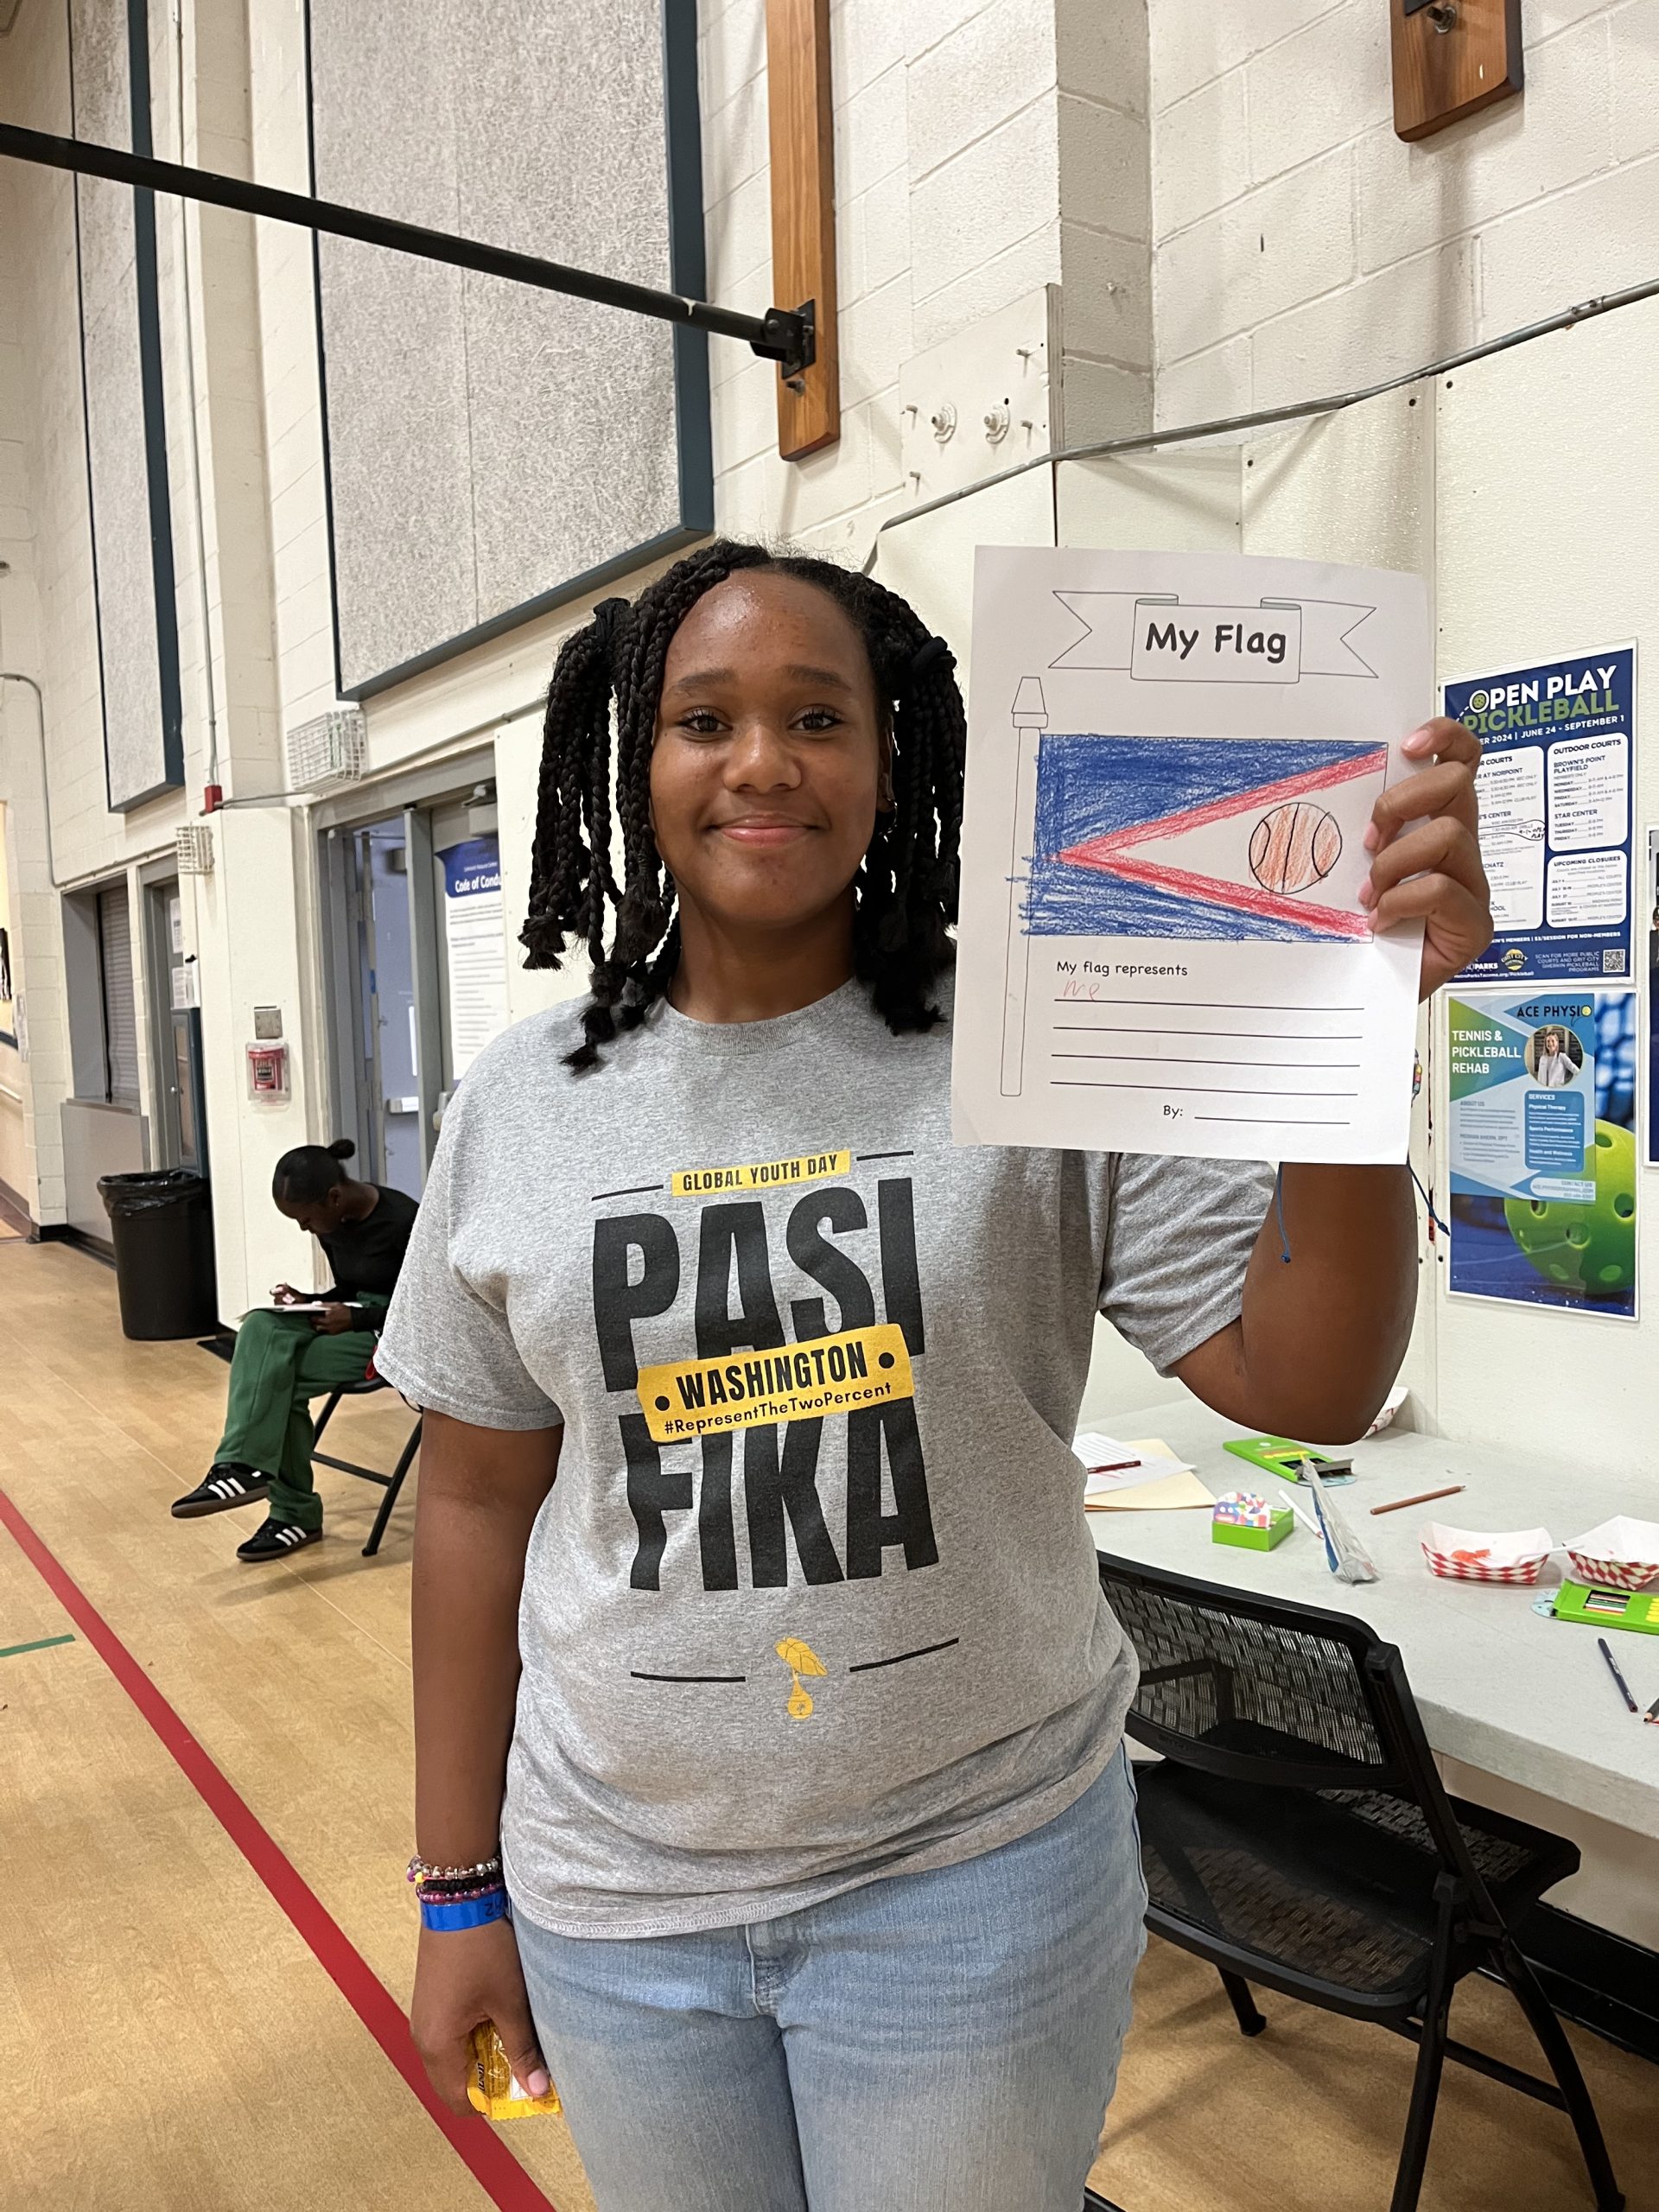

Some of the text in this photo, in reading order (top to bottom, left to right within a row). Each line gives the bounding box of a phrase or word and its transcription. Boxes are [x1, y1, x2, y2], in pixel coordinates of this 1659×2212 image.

[1146, 623, 1286, 664] My Flag
[1469, 664, 1617, 713] OPEN PLAY
[1462, 690, 1619, 734] PICKLEBALL
[1491, 734, 1512, 744] 2024
[1521, 727, 1543, 739] JUNE
[1546, 726, 1556, 736] 24
[1564, 716, 1618, 732] SEPTEMBER
[1554, 739, 1621, 755] OUTDOOR COURTS
[1485, 756, 1513, 766] COURTS
[1586, 755, 1605, 764] POINT
[1553, 765, 1589, 774] PLAYFIELD
[454, 879, 470, 893] Code
[471, 876, 480, 890] of
[1057, 961, 1188, 977] My flag represents
[1516, 1004, 1592, 1019] ACE PHYSIO
[1452, 1029, 1503, 1042] TENNIS &
[1452, 1046, 1522, 1058] PICKLEBALL
[1452, 1063, 1490, 1074] REHAB
[1163, 1105, 1183, 1119] By:
[683, 1154, 837, 1191] GLOBAL YOUTH DAY
[592, 1177, 925, 1393] PASI
[676, 1341, 868, 1410] WASHINGTON
[664, 1382, 892, 1434] #RepresentTheTwoPercent
[618, 1397, 939, 1591] FIKA
